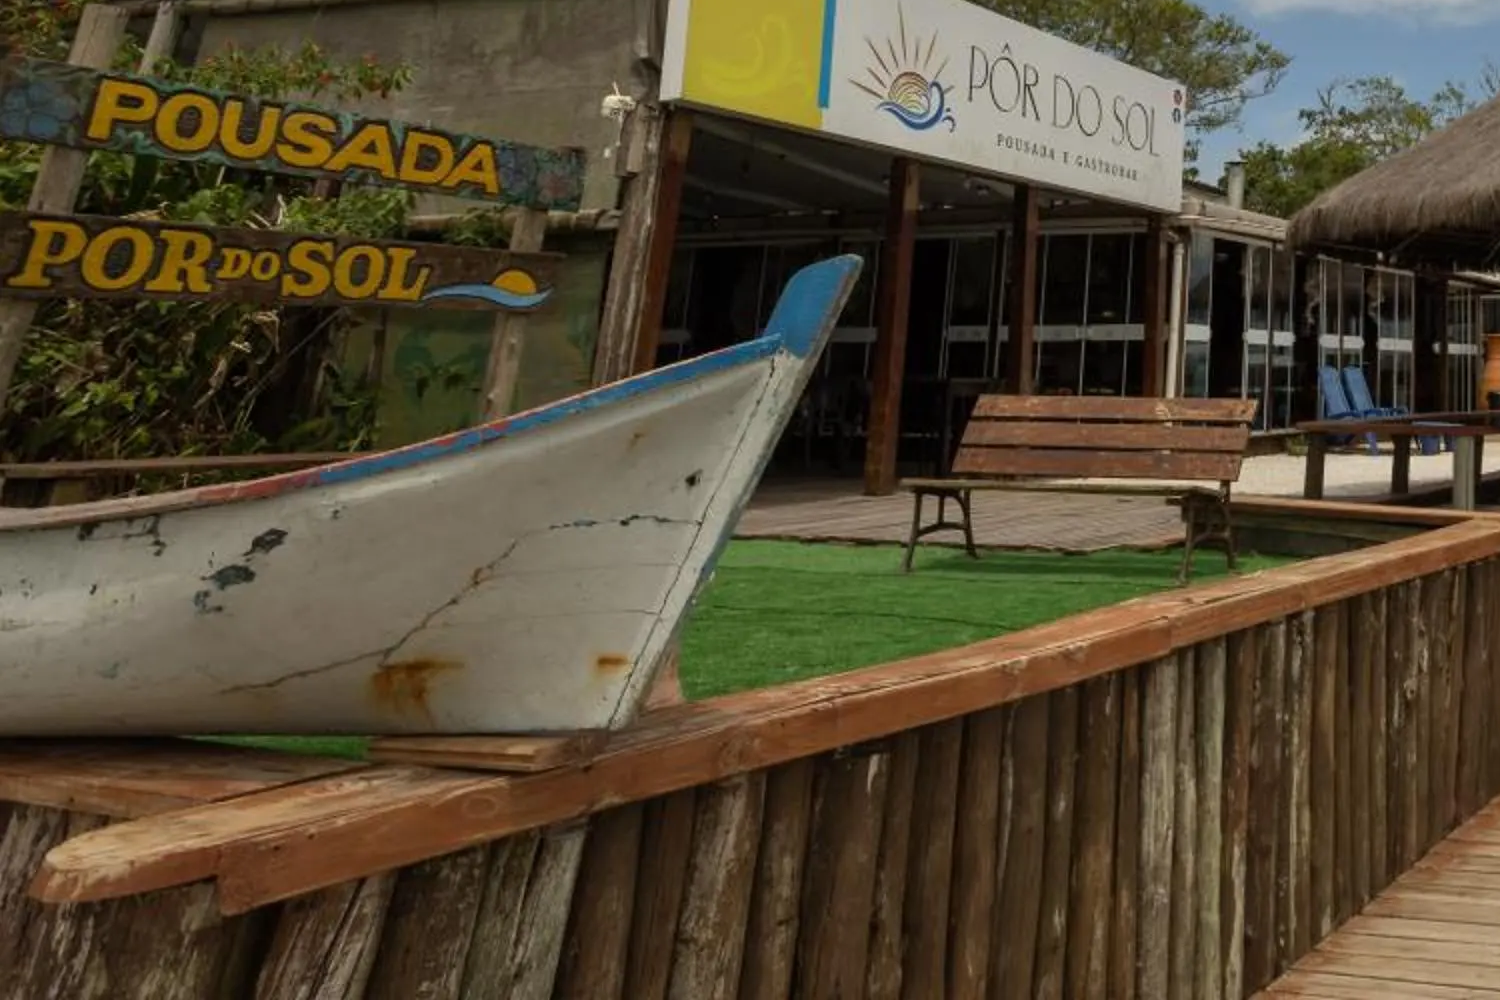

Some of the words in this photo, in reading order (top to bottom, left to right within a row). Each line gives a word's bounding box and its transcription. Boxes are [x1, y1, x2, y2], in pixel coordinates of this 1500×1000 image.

[86, 78, 500, 194] POUSADA
[968, 42, 1040, 122] PÔR
[1052, 74, 1101, 137] DO
[1111, 94, 1160, 157] SOL
[996, 133, 1055, 161] POUSADA
[1062, 151, 1069, 164] E
[8, 219, 215, 293] POR
[217, 247, 282, 281] DO
[282, 240, 431, 301] SOL
